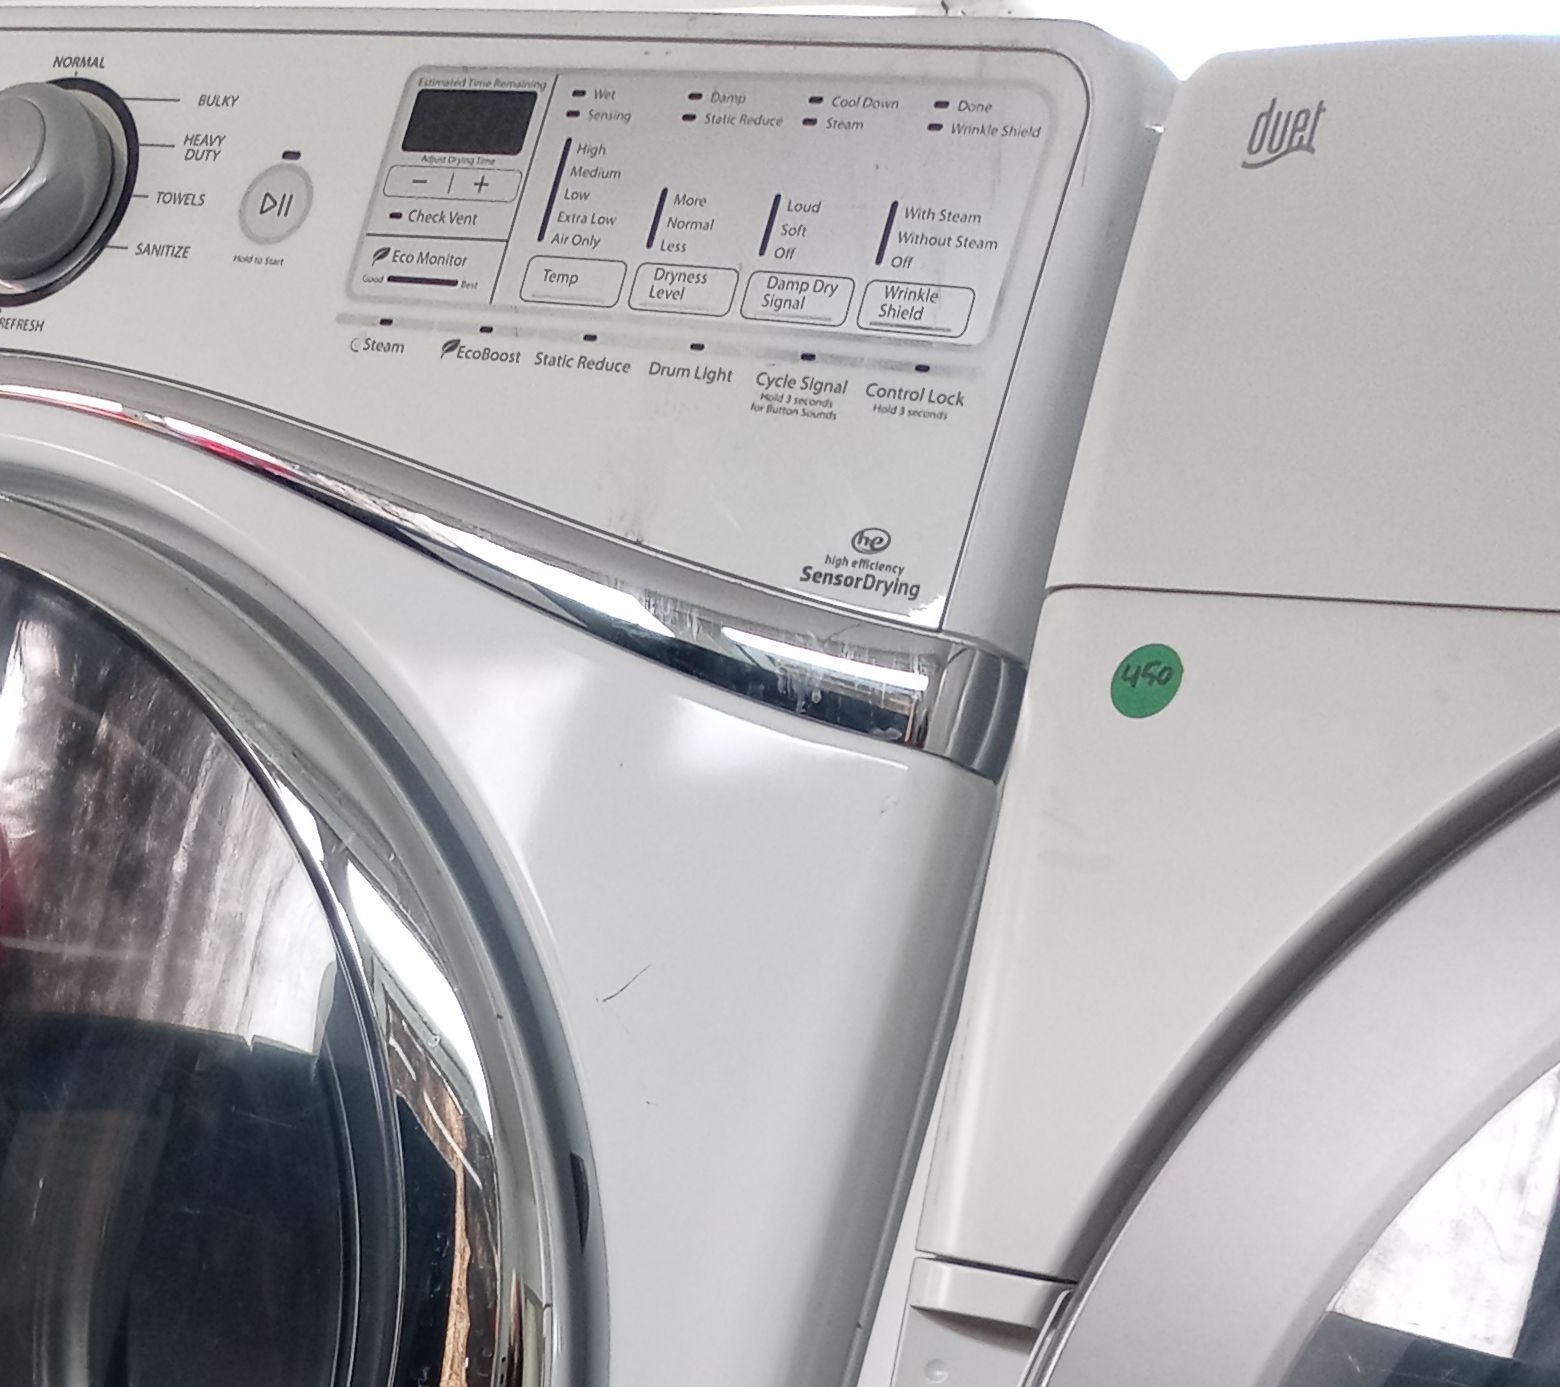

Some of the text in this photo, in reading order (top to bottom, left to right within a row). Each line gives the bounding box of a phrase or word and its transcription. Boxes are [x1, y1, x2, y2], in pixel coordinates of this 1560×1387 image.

[52, 56, 105, 69] NORMAL
[418, 78, 547, 92] Estimated Time Remaining
[198, 95, 239, 107] BULKY
[594, 89, 616, 100] Wet
[710, 91, 746, 106] Damp
[832, 96, 899, 110] Cool Down
[958, 100, 992, 113] Done
[588, 109, 631, 124] Sensing
[704, 114, 783, 127] Static Reduce
[826, 117, 863, 130] Steam
[951, 123, 1041, 139] Wrinkle Shield
[1243, 98, 1326, 166] duet
[184, 134, 226, 147] HEAVY
[184, 149, 220, 161] DUTY
[576, 144, 606, 157] High
[570, 167, 621, 179] Medium
[156, 192, 205, 206] TOWELS
[564, 189, 590, 200] Low
[674, 194, 706, 207] More
[787, 201, 821, 214] Loud
[904, 206, 981, 223] With Steam
[408, 209, 477, 226] Check Vent
[557, 212, 616, 225] Extra Low
[667, 218, 714, 231] Normal
[781, 224, 806, 237] Soft
[551, 233, 601, 249] Air Only
[660, 240, 686, 253] Less
[898, 231, 998, 250] Without Steam
[136, 243, 190, 258] SANITIZE
[774, 247, 796, 260] Off
[392, 250, 467, 267] Eco Monitor
[891, 256, 914, 269] Off
[543, 268, 578, 286] Temp
[653, 267, 707, 285] Dryness
[649, 285, 685, 300] Level
[767, 275, 838, 297] Damp Dry
[884, 285, 939, 303] Wrinkle
[761, 294, 805, 312] Signal
[878, 304, 924, 321] Shield
[363, 338, 404, 353] Steam
[456, 345, 520, 364] EcoBoost
[534, 352, 631, 373] Static Reduce
[649, 362, 733, 384] Drum Light
[756, 372, 848, 395] Cycle Signal
[760, 392, 833, 408] Hold seconds
[866, 383, 965, 406] Control Lock
[766, 404, 837, 420] Button Sounds
[873, 404, 947, 420] Hold 3 seconds
[825, 554, 904, 576] high efficiency
[800, 566, 920, 600] SensorDrying
